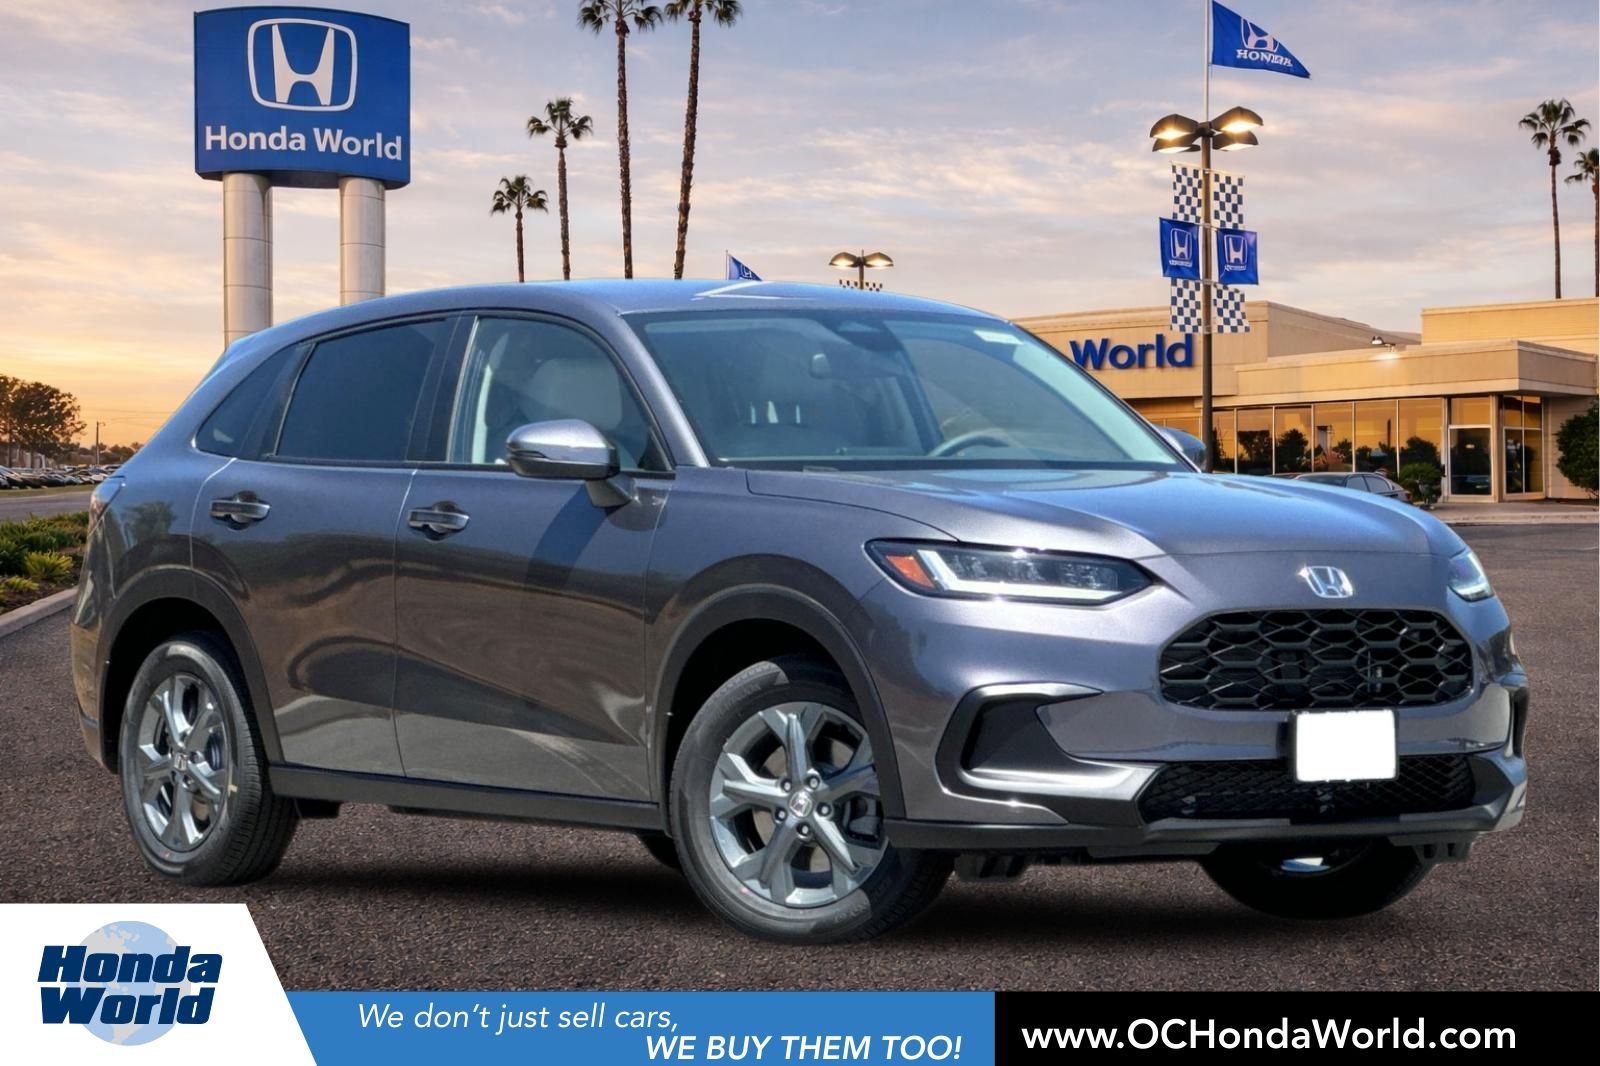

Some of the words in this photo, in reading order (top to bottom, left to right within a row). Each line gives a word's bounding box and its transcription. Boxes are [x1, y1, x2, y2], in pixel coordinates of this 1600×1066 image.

[205, 125, 306, 151] Honda
[313, 127, 402, 161] World
[1069, 333, 1193, 370] World
